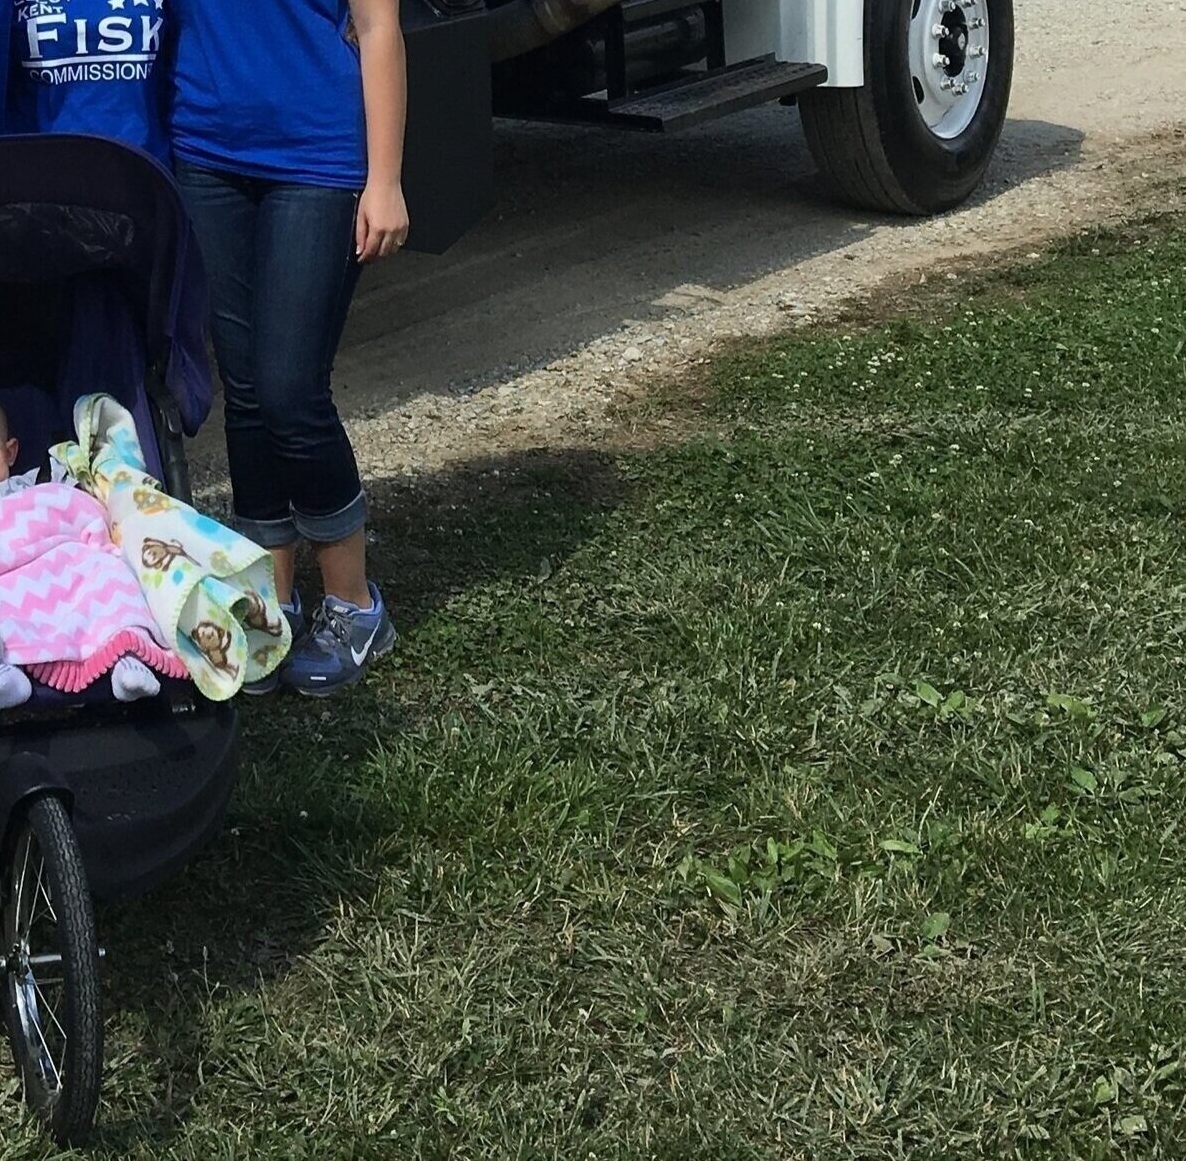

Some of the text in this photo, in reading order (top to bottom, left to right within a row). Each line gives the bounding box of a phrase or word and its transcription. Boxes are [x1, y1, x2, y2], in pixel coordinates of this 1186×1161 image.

[18, 3, 63, 22] KENT
[27, 13, 164, 59] FISK
[30, 63, 153, 85] COMMISSION
